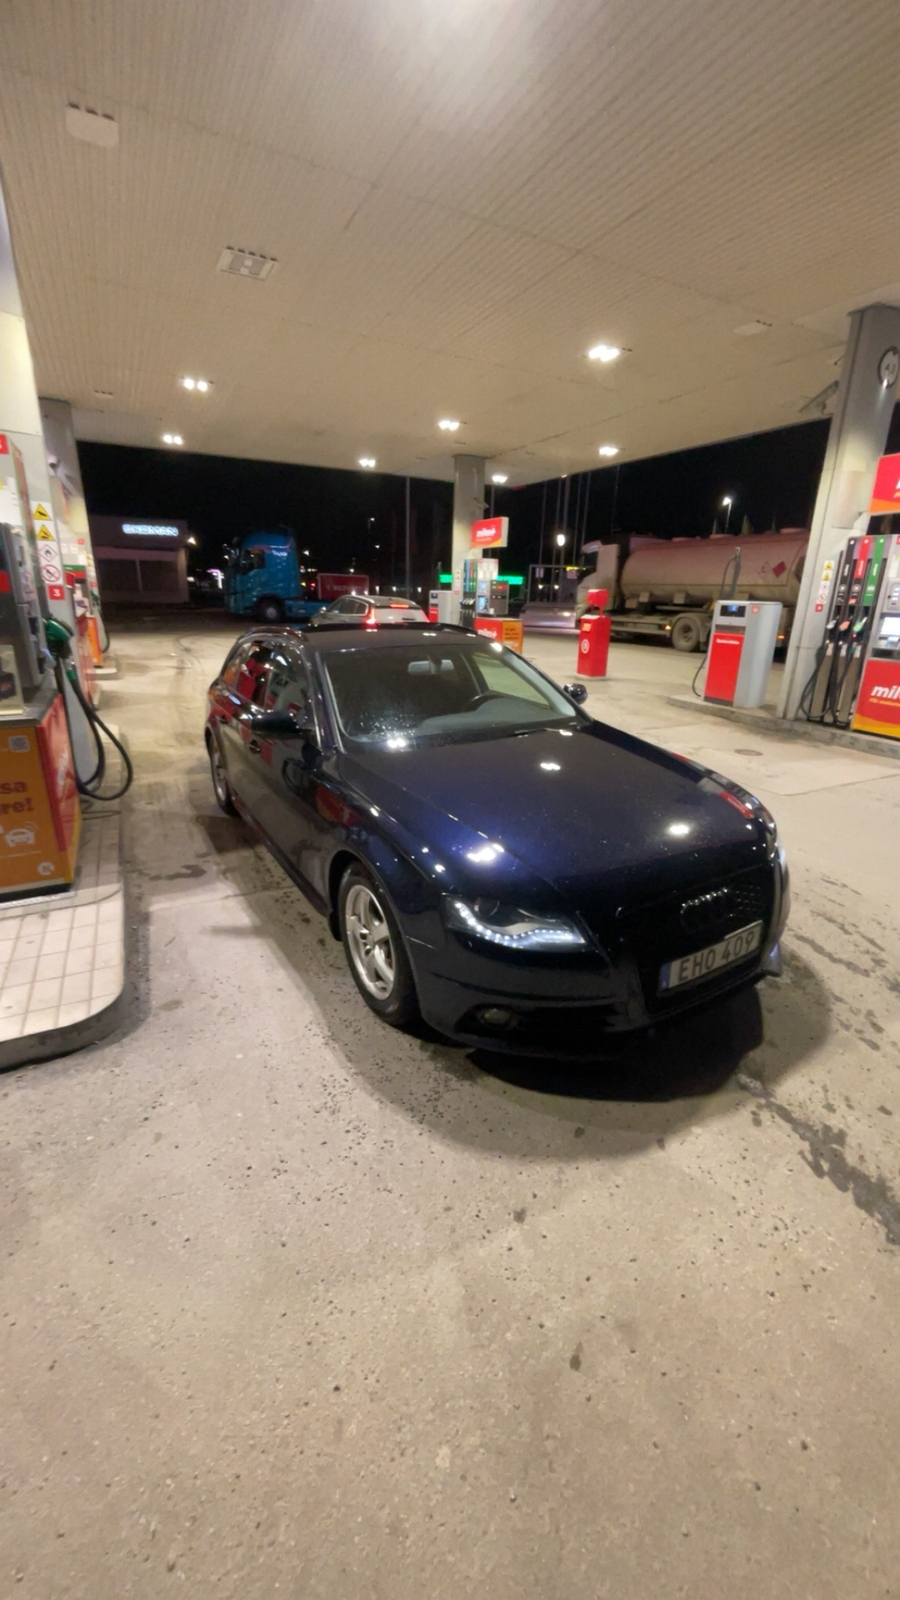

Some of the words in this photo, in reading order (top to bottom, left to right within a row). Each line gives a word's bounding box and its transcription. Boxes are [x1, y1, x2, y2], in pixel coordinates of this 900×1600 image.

[870, 685, 900, 700] mil
[0, 781, 28, 795] sa
[0, 797, 34, 815] re!
[679, 949, 716, 983] EHO
[721, 930, 756, 963] 409
